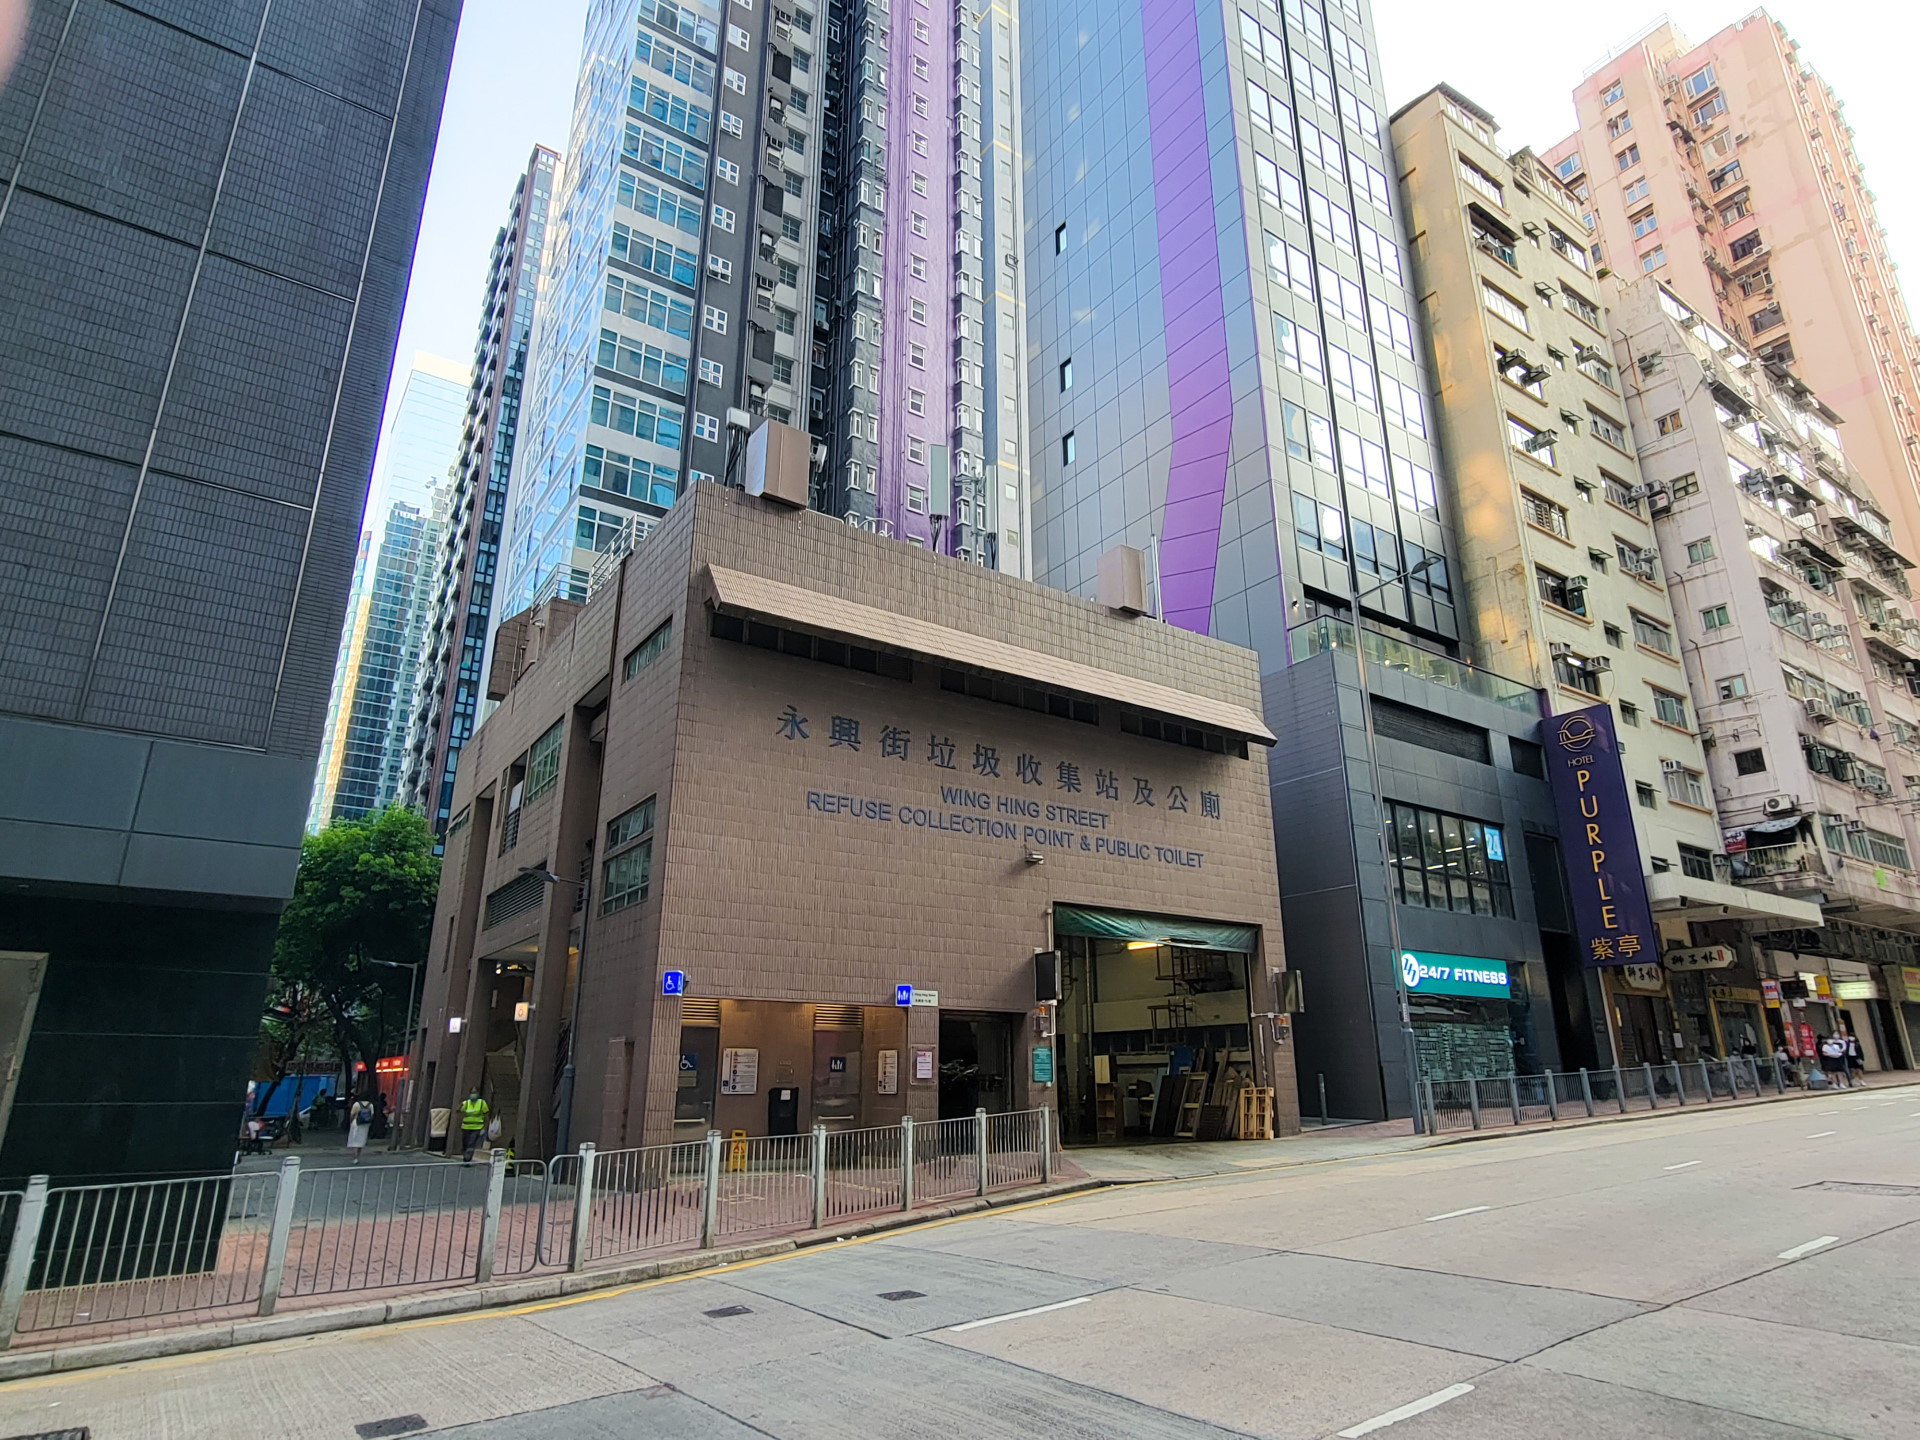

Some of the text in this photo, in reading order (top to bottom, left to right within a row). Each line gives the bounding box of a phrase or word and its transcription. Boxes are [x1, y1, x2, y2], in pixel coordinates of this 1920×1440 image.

[776, 704, 1221, 820] 永興街垃圾收集站及公廁
[1567, 754, 1595, 768] HOTEL
[807, 790, 1204, 869] REFUSE COLLECTION POINT & PUBLIC TOILET
[940, 785, 1109, 830] WING HING STREET
[1576, 769, 1618, 929] PURPLE
[1590, 934, 1641, 960] 紫亭
[1418, 964, 1508, 985] 24/7 FITNESS
